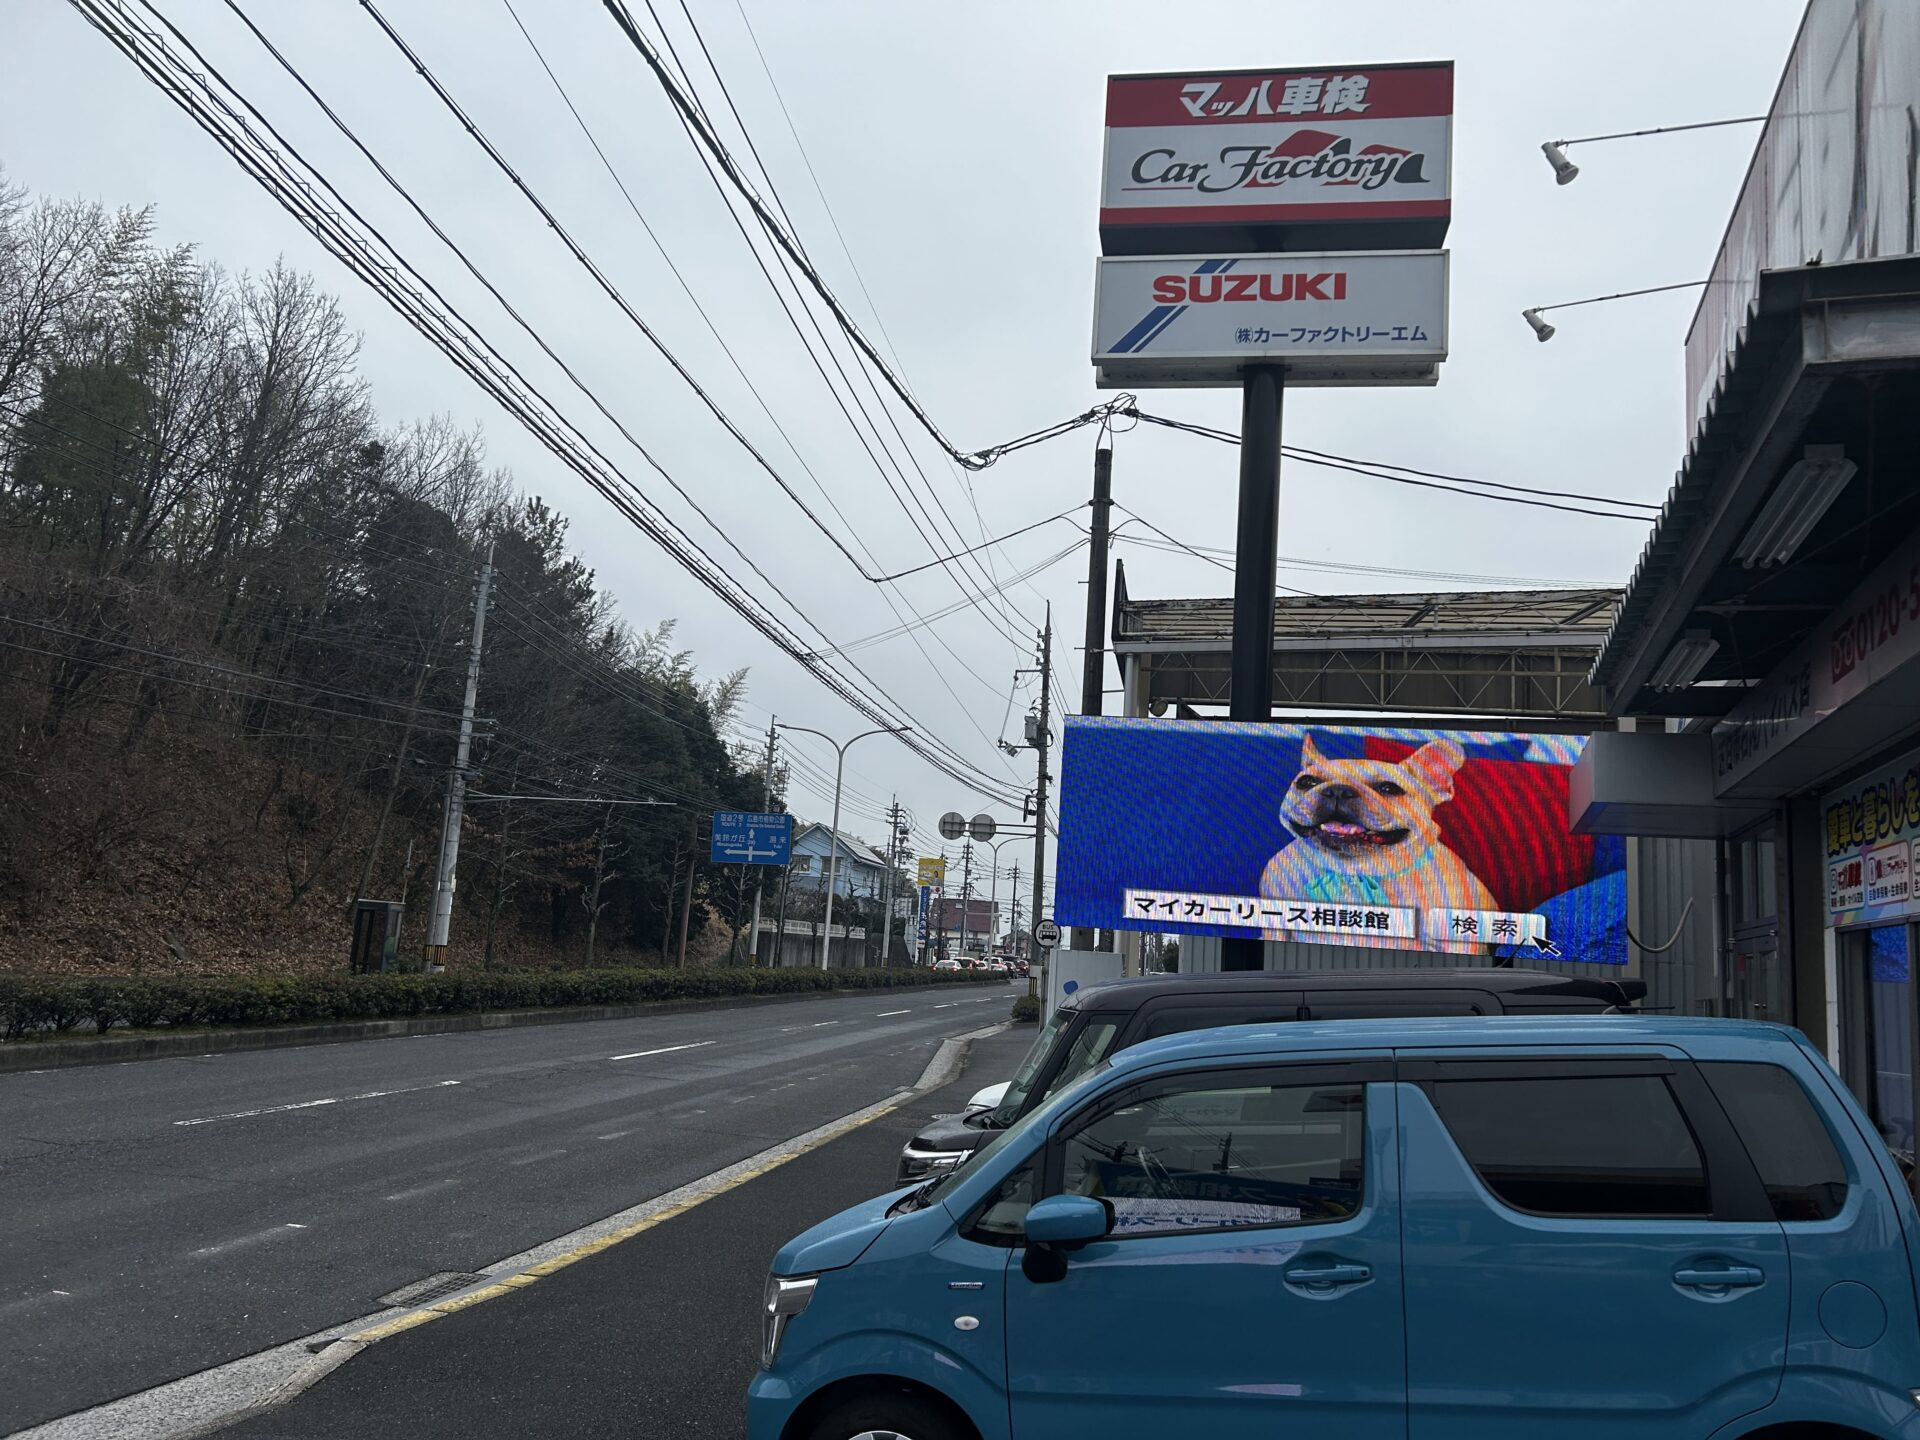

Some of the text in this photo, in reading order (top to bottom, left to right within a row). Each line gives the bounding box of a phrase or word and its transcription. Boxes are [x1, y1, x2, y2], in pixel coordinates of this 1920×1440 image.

[1179, 75, 1372, 117] マッハ車検
[1131, 146, 1396, 193] Car Factory
[1152, 273, 1347, 303] SUZUKI
[1235, 326, 1428, 344] (株)カーファクトリーエム
[1133, 898, 1389, 931] マイカーリース相談館
[1452, 915, 1518, 937] 検索
